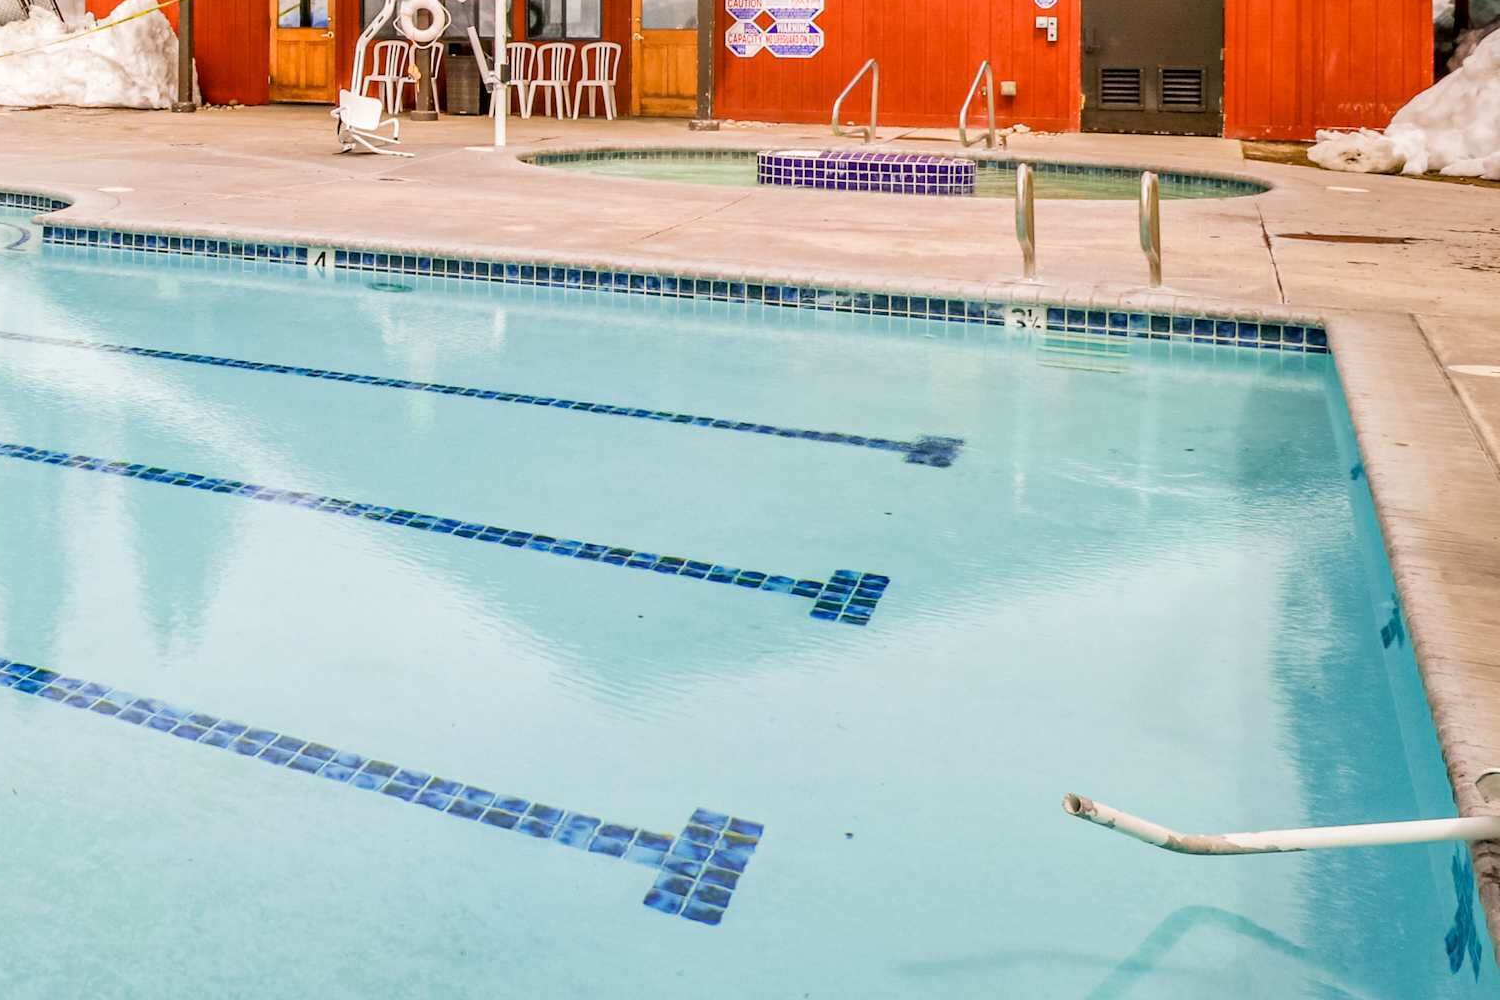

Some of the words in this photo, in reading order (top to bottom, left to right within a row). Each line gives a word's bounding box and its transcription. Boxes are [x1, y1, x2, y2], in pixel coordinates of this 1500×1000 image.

[727, 0, 762, 8] CAUTION
[777, 23, 810, 33] WARNING
[727, 34, 763, 44] CAPACITY
